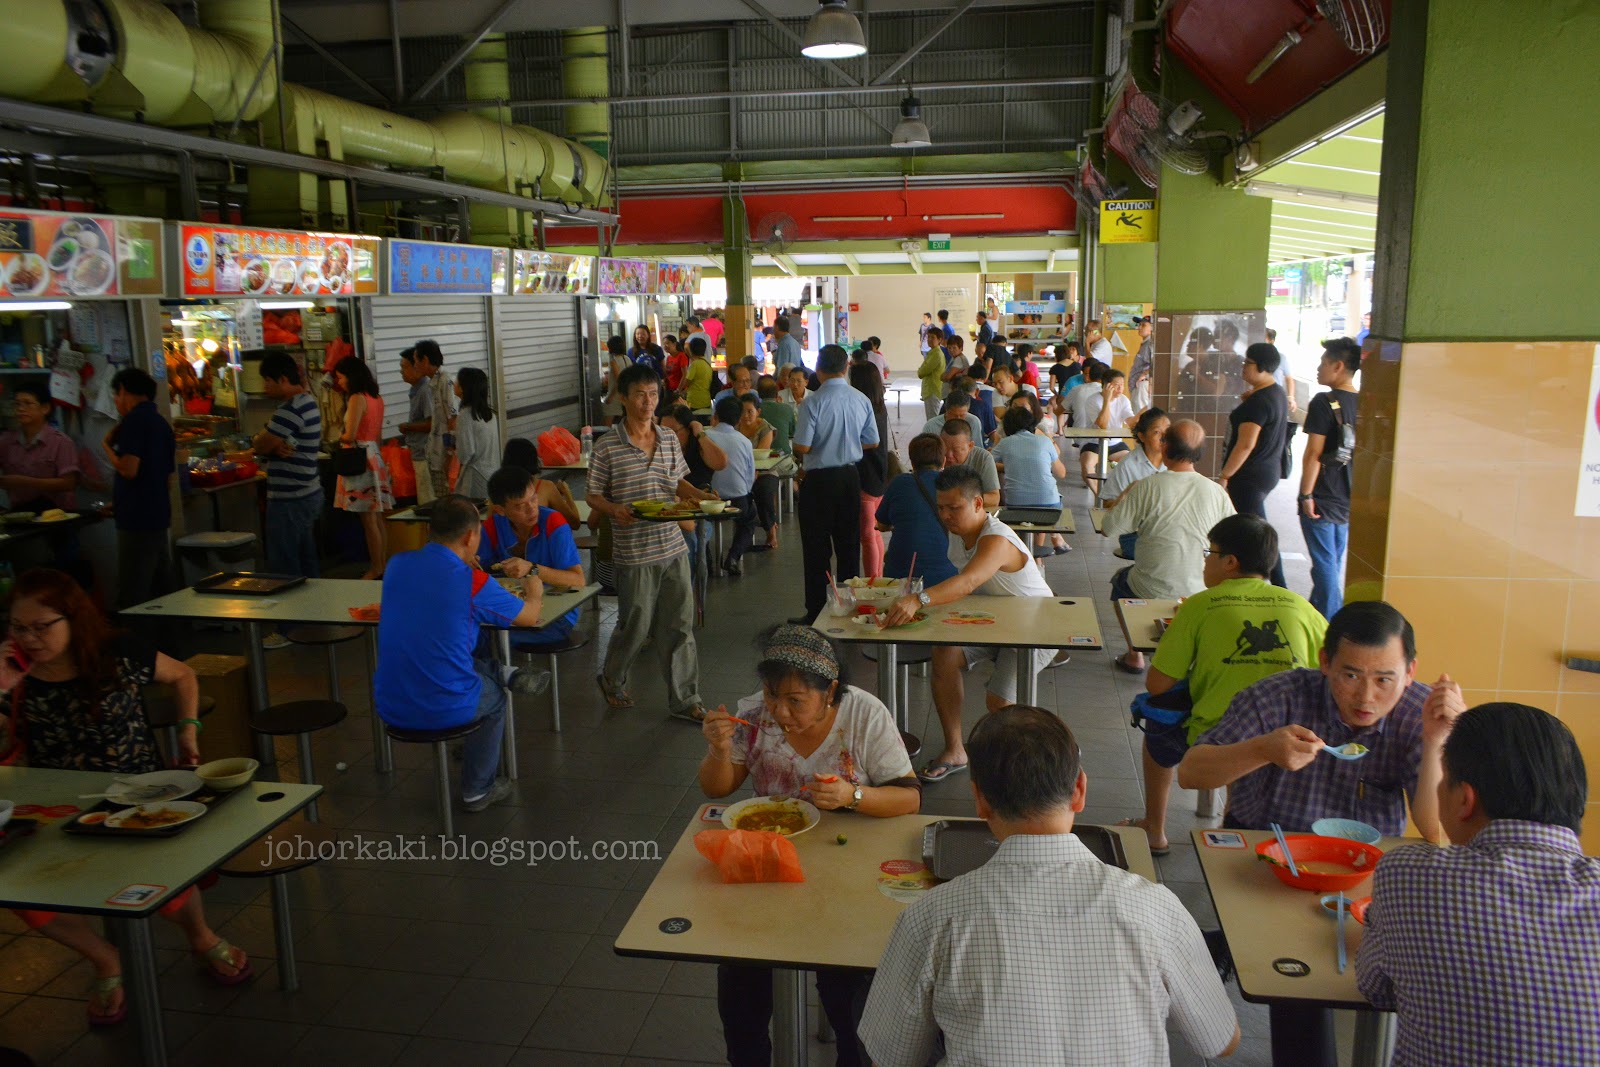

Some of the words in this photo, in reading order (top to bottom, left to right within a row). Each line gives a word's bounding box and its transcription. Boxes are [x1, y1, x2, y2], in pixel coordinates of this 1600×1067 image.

[1107, 201, 1152, 211] CAUTION
[932, 241, 946, 249] EXIT
[1244, 595, 1275, 603] Secondary
